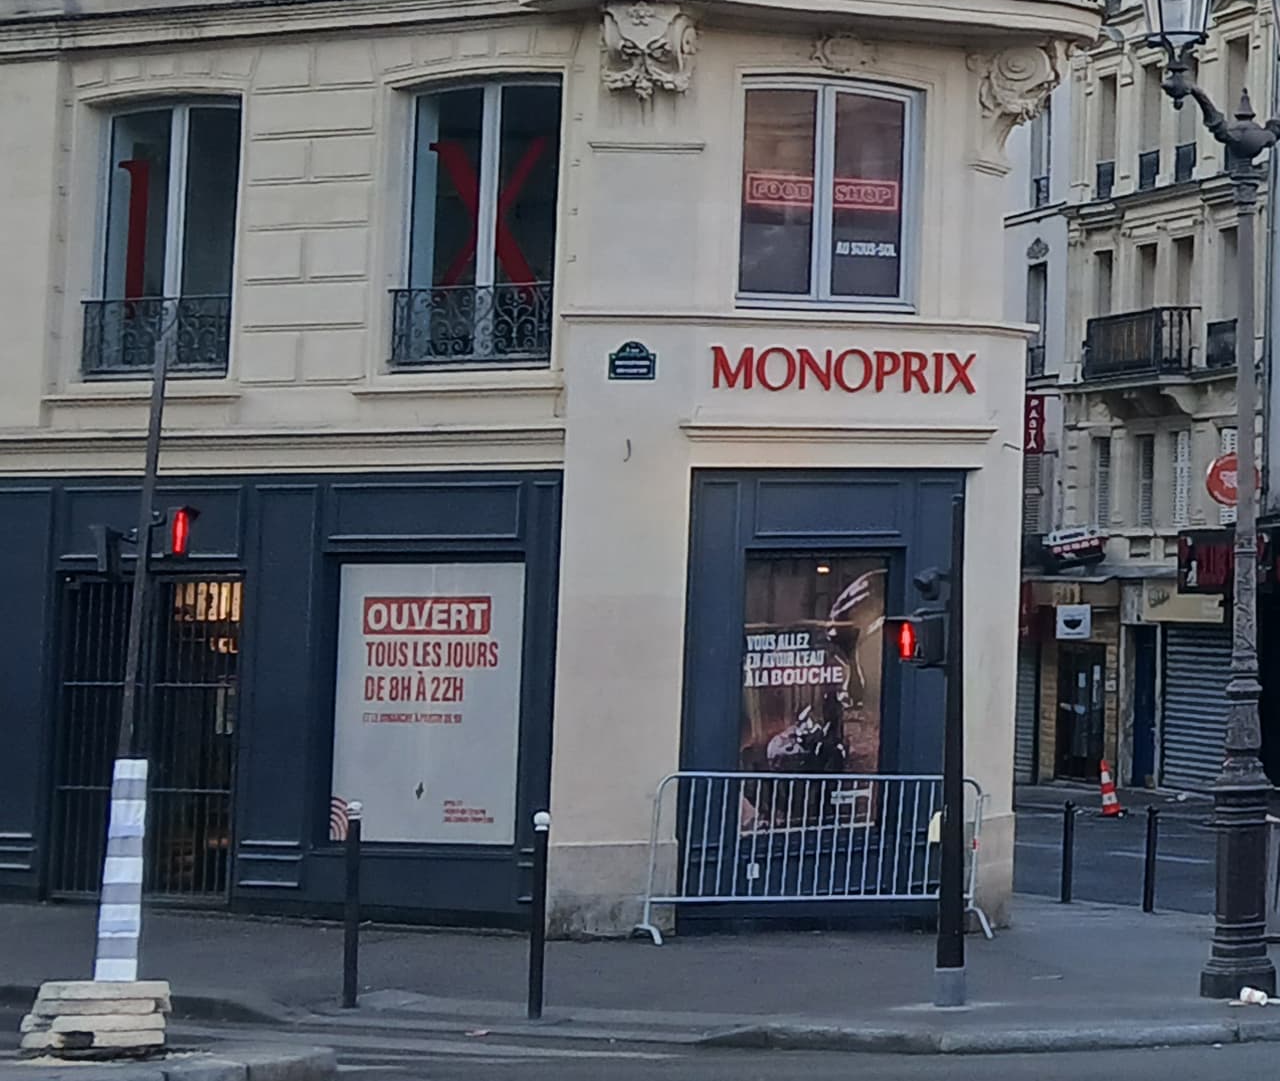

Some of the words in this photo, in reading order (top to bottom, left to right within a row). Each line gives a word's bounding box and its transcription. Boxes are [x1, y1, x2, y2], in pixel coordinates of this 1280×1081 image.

[752, 179, 813, 201] FOOD
[833, 184, 893, 204] SHOP
[710, 345, 977, 395] MONOPRIX
[367, 602, 489, 631] OUVERT
[365, 641, 409, 667] TOUS
[412, 641, 443, 667] LES
[444, 641, 499, 668] JOURS
[745, 634, 777, 651] VOUS
[777, 633, 811, 650] ALLEZ
[363, 675, 386, 702] DE
[388, 675, 412, 702] 8H
[415, 670, 427, 702] À
[430, 676, 464, 702] 22H
[754, 669, 769, 687] LA
[770, 666, 843, 686] BOUCHE
